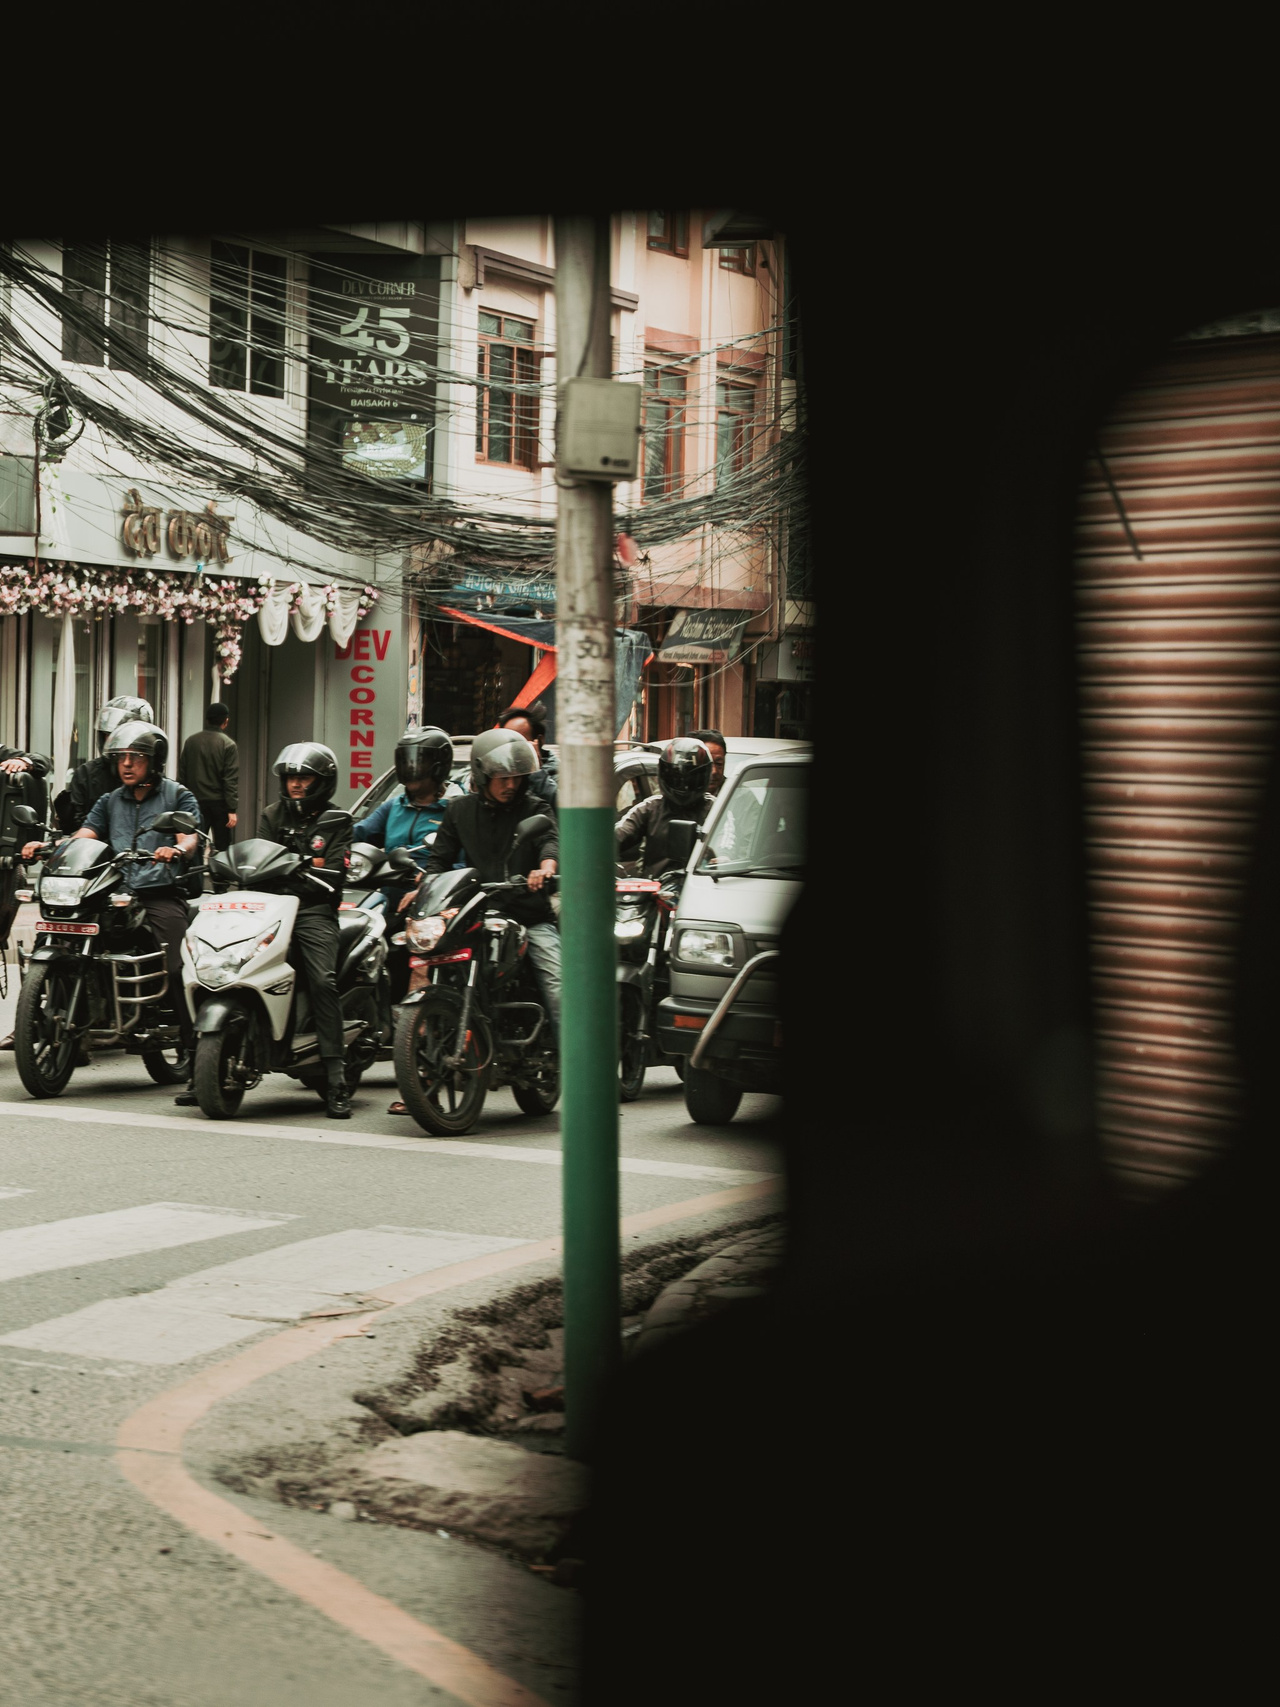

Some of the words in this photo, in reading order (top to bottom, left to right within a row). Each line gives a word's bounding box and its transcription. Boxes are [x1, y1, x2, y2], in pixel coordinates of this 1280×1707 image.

[342, 280, 365, 295] DEV
[368, 280, 415, 296] CORNER
[340, 307, 411, 358] 45
[322, 358, 428, 387] YEARS
[350, 399, 391, 407] BAISAKH
[349, 665, 376, 789] CORNER
